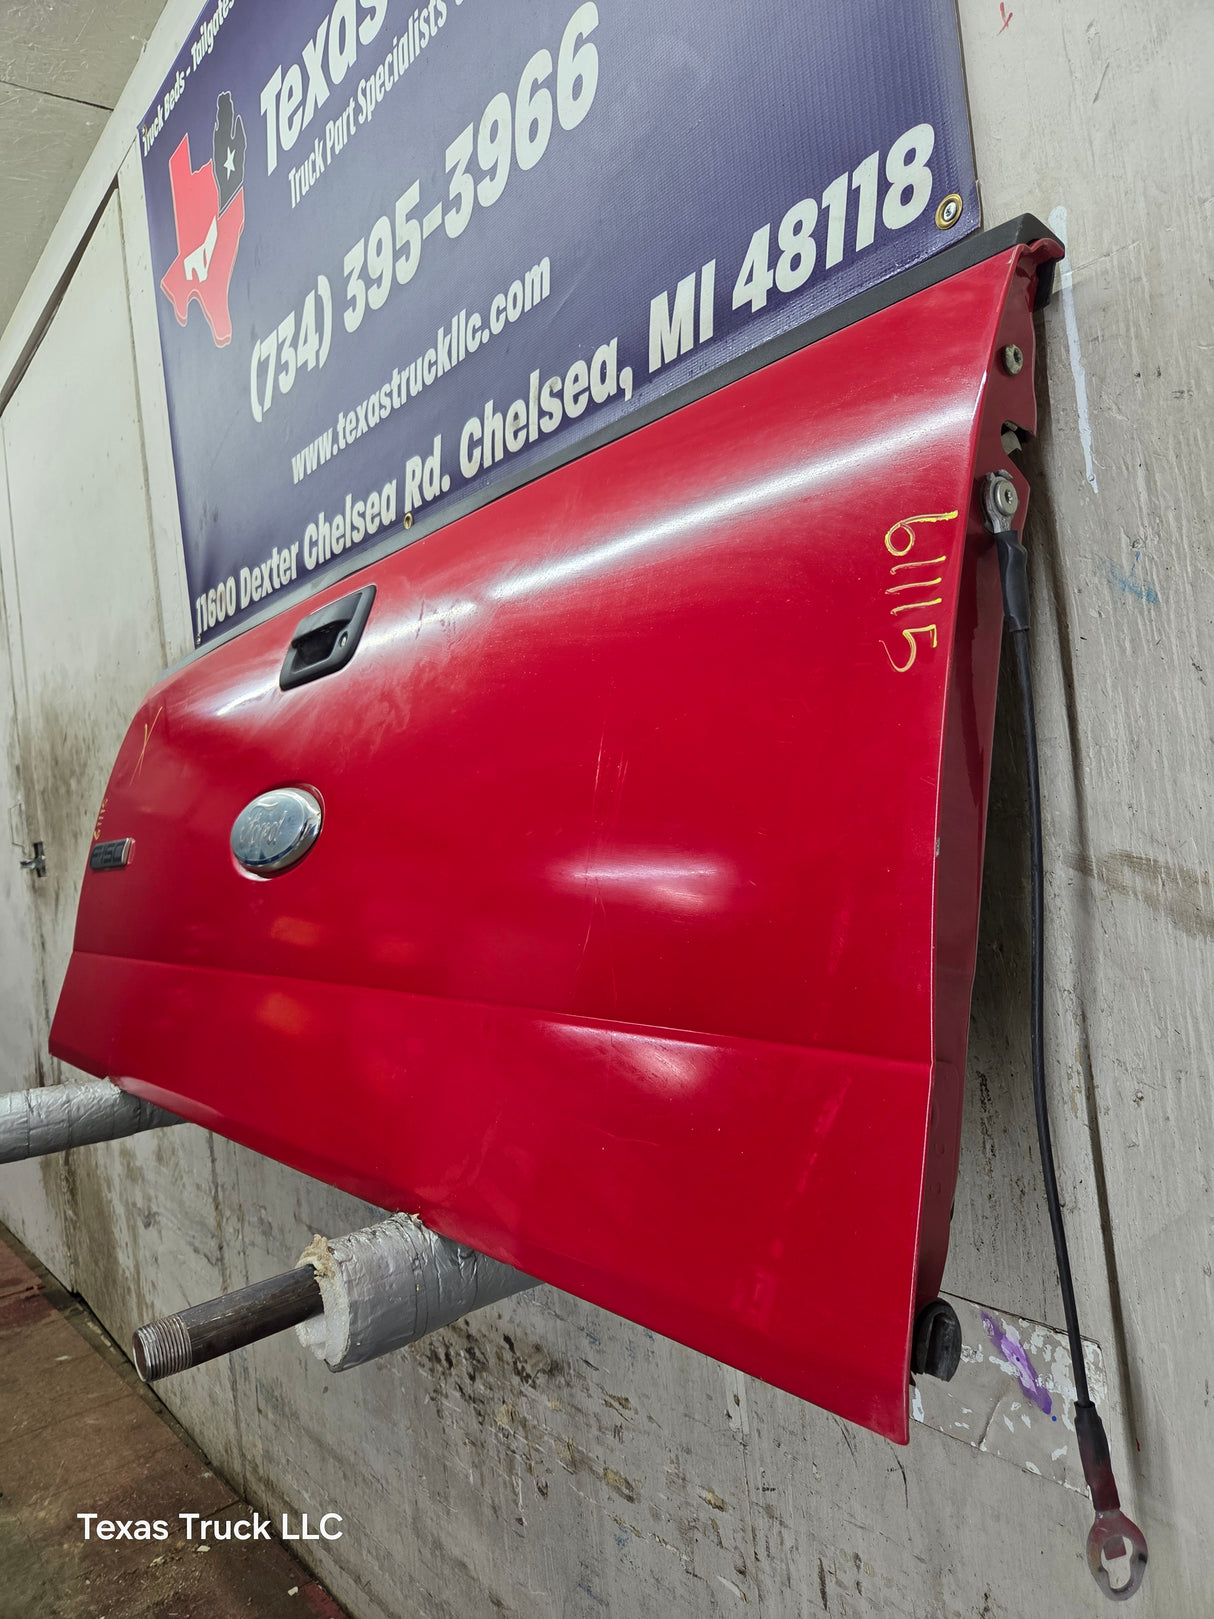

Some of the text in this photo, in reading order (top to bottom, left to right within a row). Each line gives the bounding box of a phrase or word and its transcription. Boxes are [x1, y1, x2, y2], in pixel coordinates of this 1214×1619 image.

[142, 104, 163, 157] Truck
[164, 71, 185, 120] Beds
[250, 1, 599, 422] (734) 395-3966
[289, 137, 323, 208] Truck
[325, 97, 357, 165] Part
[196, 123, 935, 634] 11600 Dexter Chelsea Rd. Chelsea, MI 48118
[291, 256, 551, 484] www.texastruckllc.com
